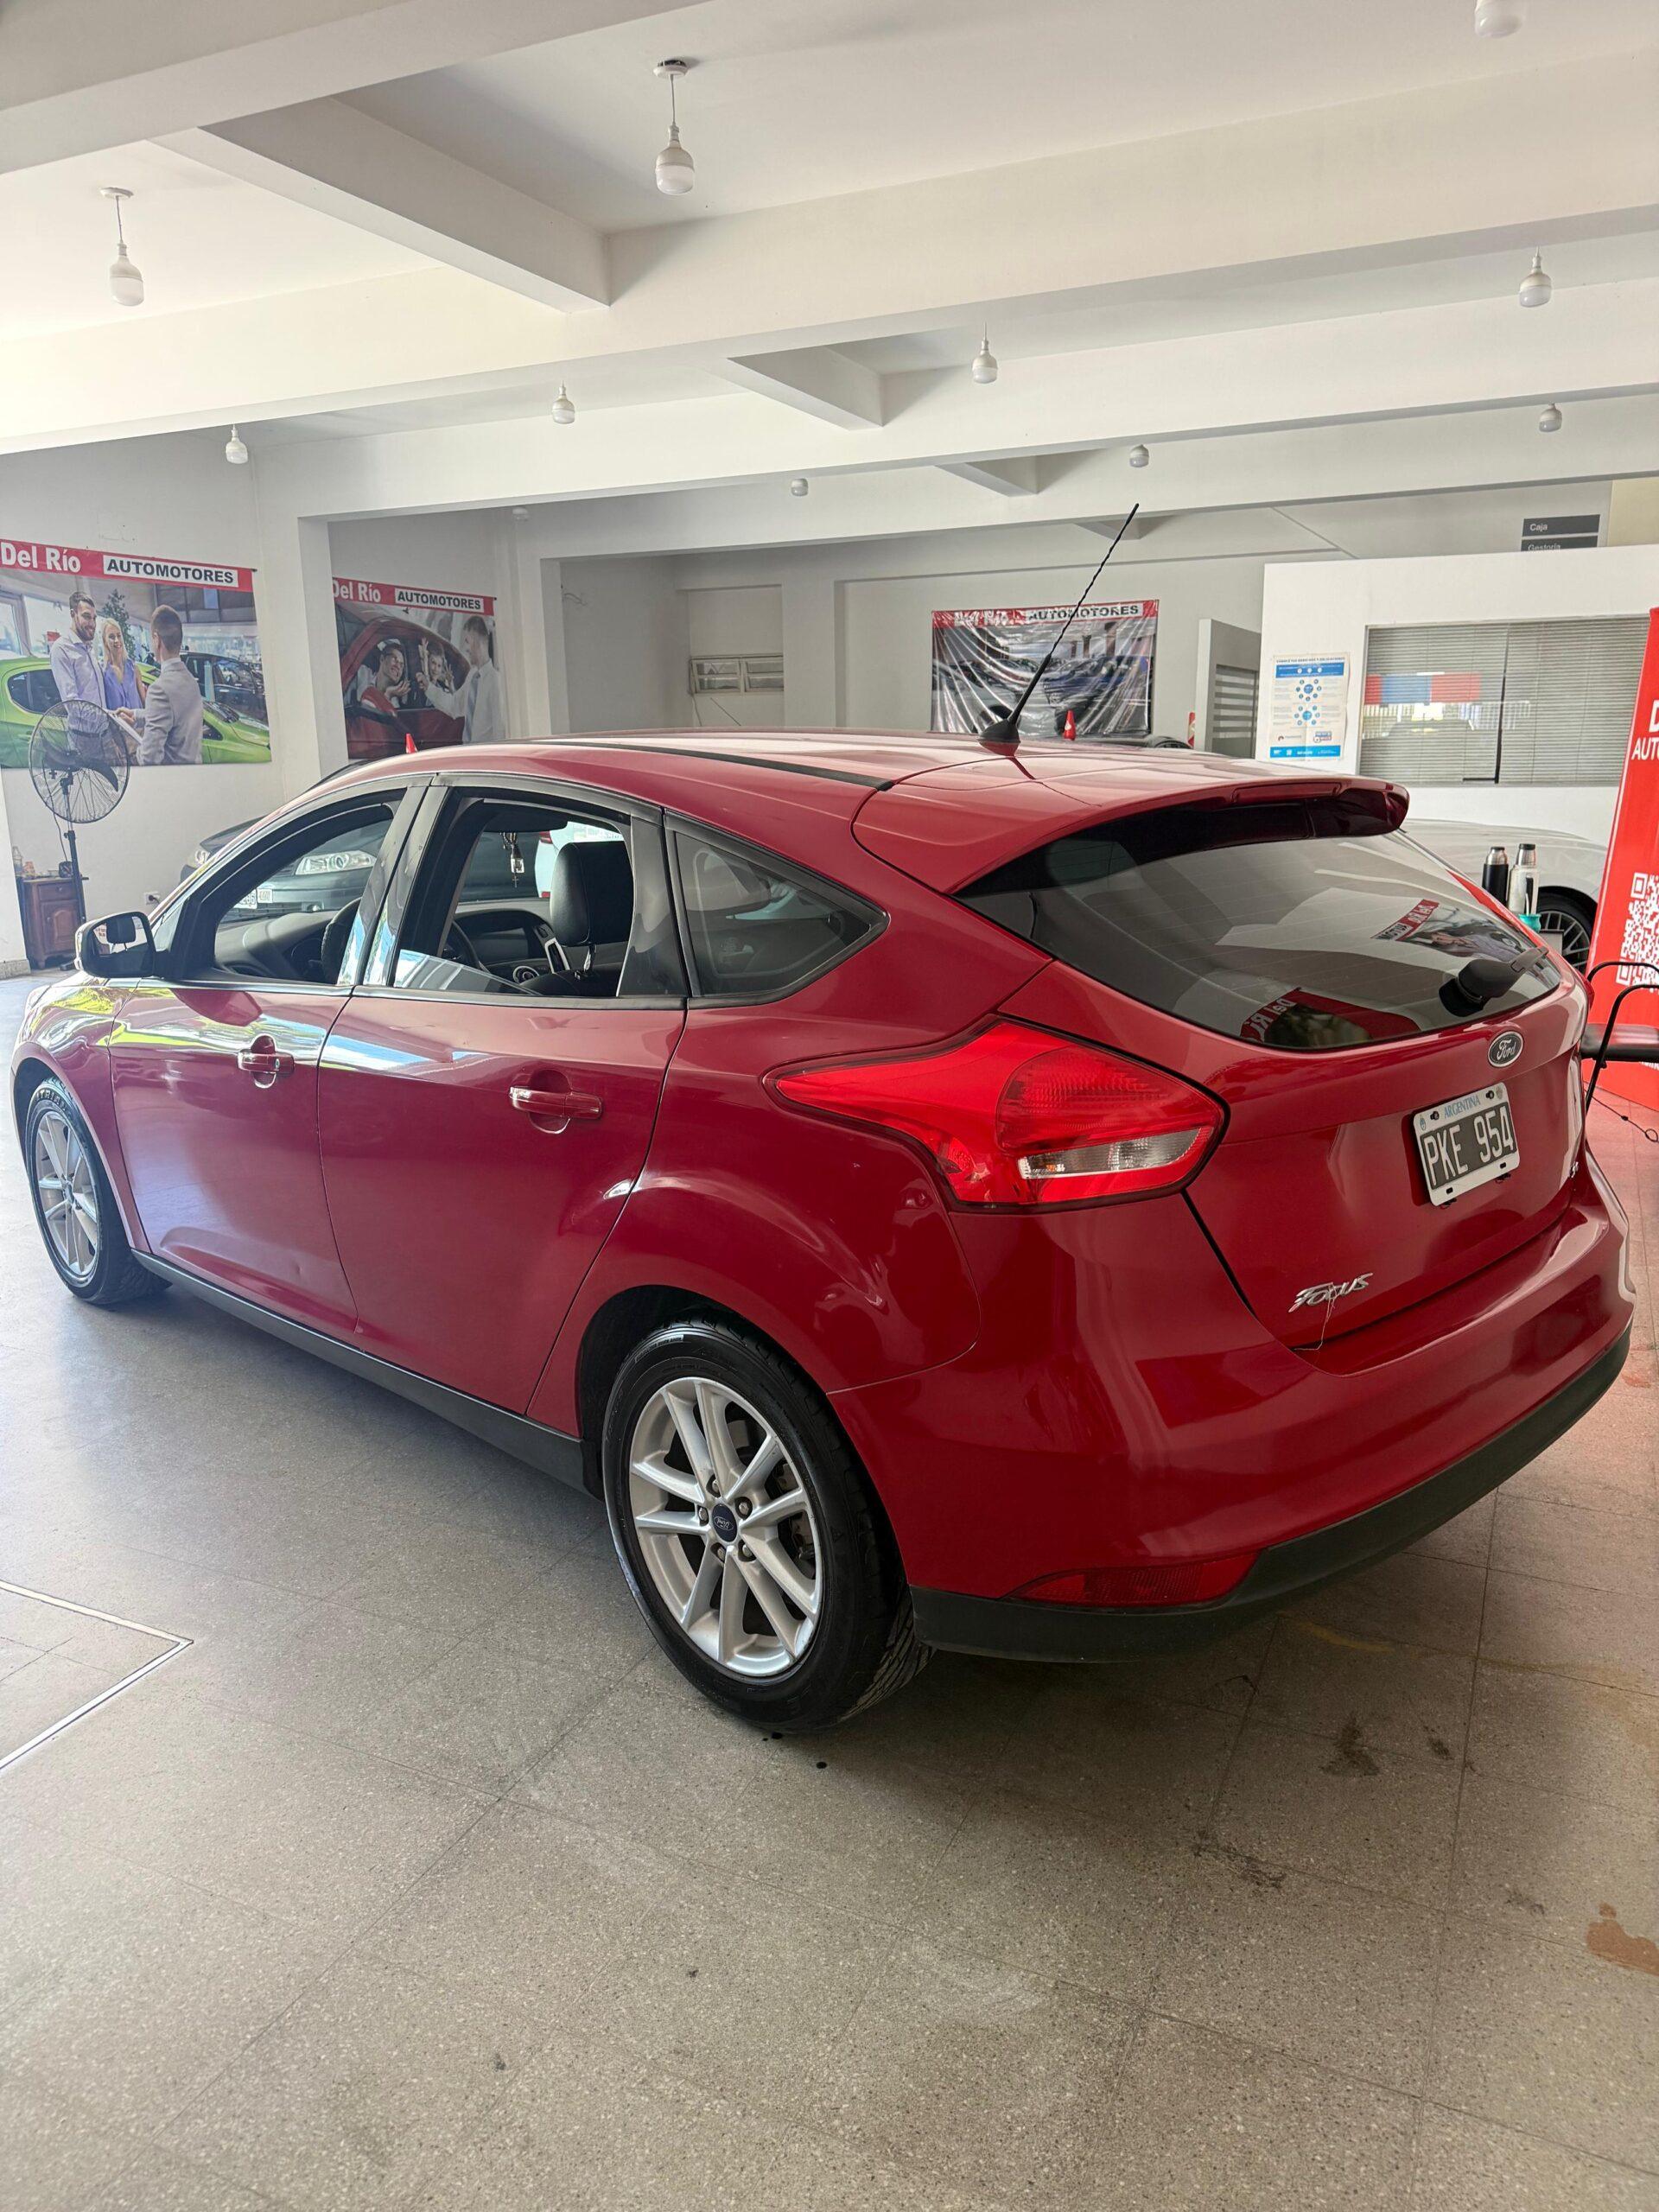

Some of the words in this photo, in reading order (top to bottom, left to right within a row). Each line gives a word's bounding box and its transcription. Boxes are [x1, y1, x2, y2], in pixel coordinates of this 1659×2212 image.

[1529, 524, 1548, 532] Caja
[1, 542, 37, 569] Del
[45, 547, 81, 573] Río
[107, 559, 234, 584] AUTOMOTORES
[333, 580, 353, 601] Del
[358, 582, 382, 603] Río
[397, 590, 481, 610] AUTOMOTORES
[1631, 737, 1659, 760] AUT
[1497, 1039, 1517, 1061] Ford
[1444, 1095, 1481, 1119] ARGENTINA
[1424, 1124, 1469, 1186] PKE
[1474, 1105, 1514, 1164] 954
